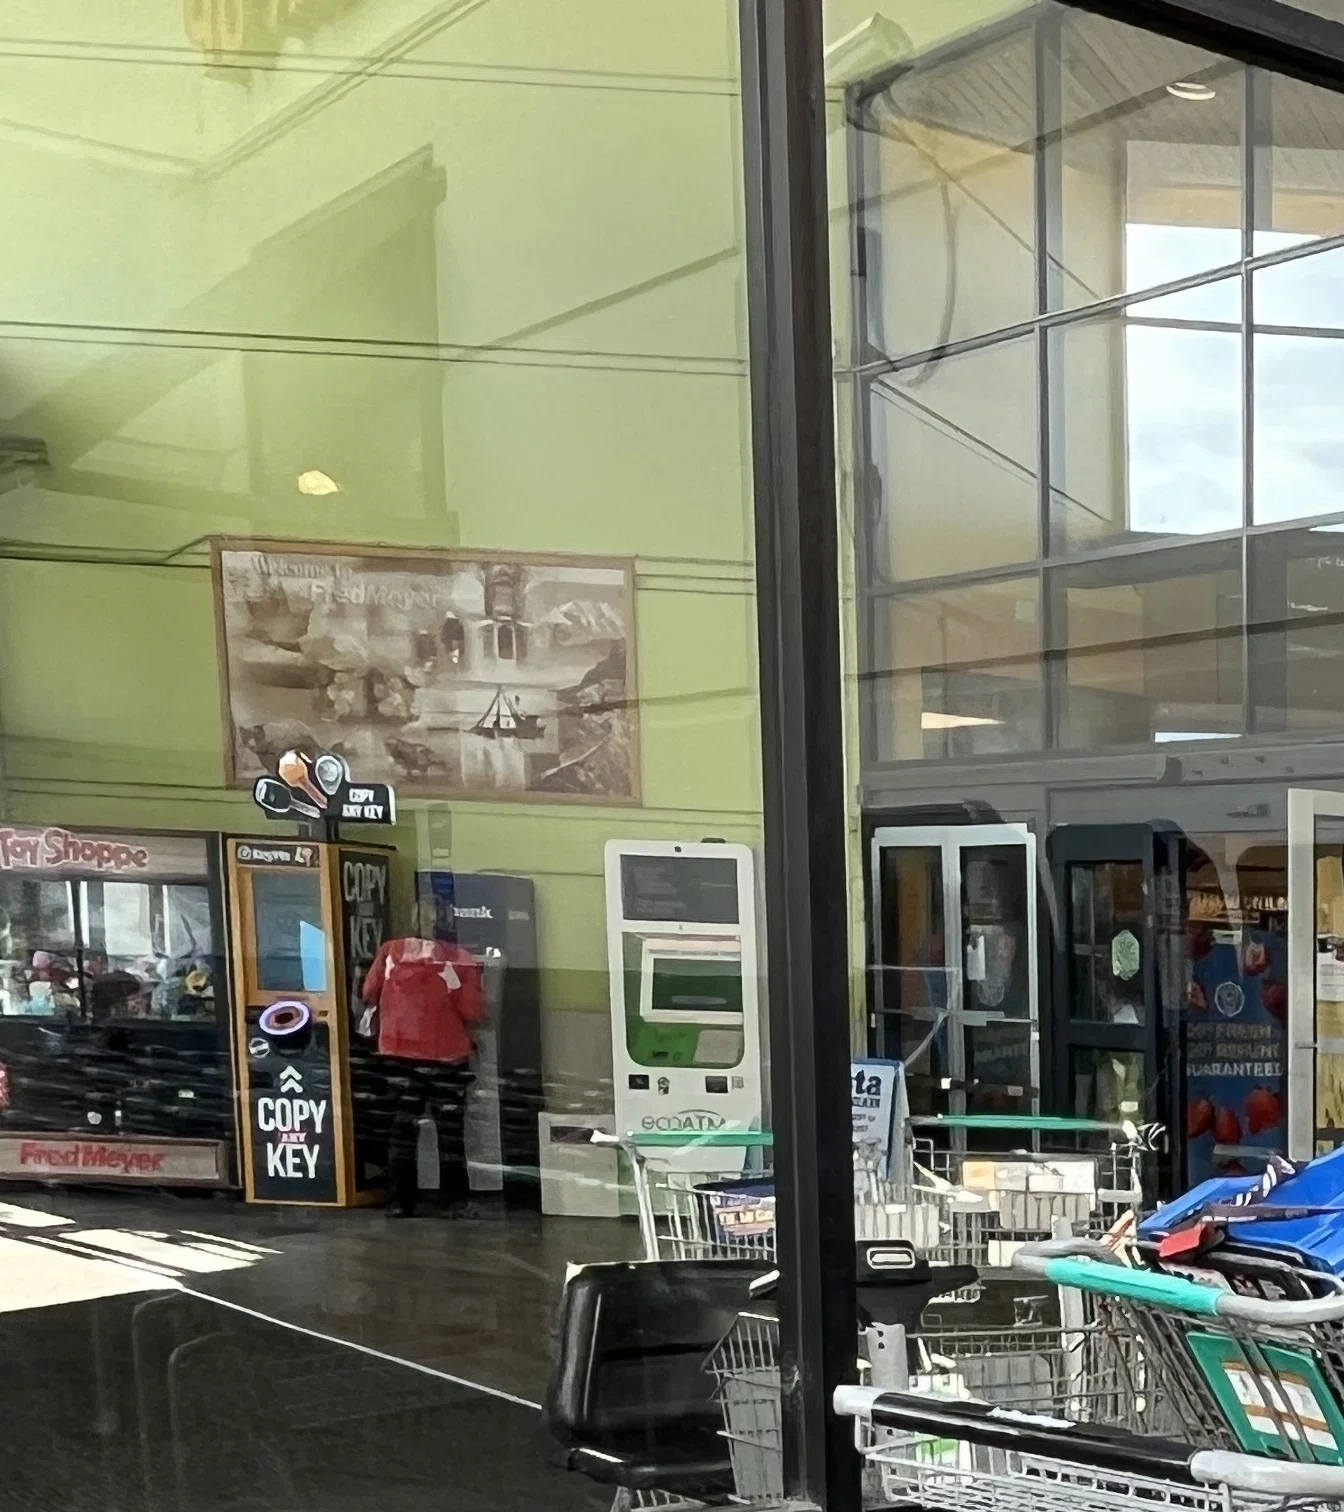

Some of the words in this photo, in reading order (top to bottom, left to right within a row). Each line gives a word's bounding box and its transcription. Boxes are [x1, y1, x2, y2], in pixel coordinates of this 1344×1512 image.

[42, 827, 149, 873] Shoppe
[343, 861, 387, 901] COPY
[351, 915, 384, 959] KEY
[258, 1097, 326, 1133] COPY
[267, 1142, 319, 1179] KEY
